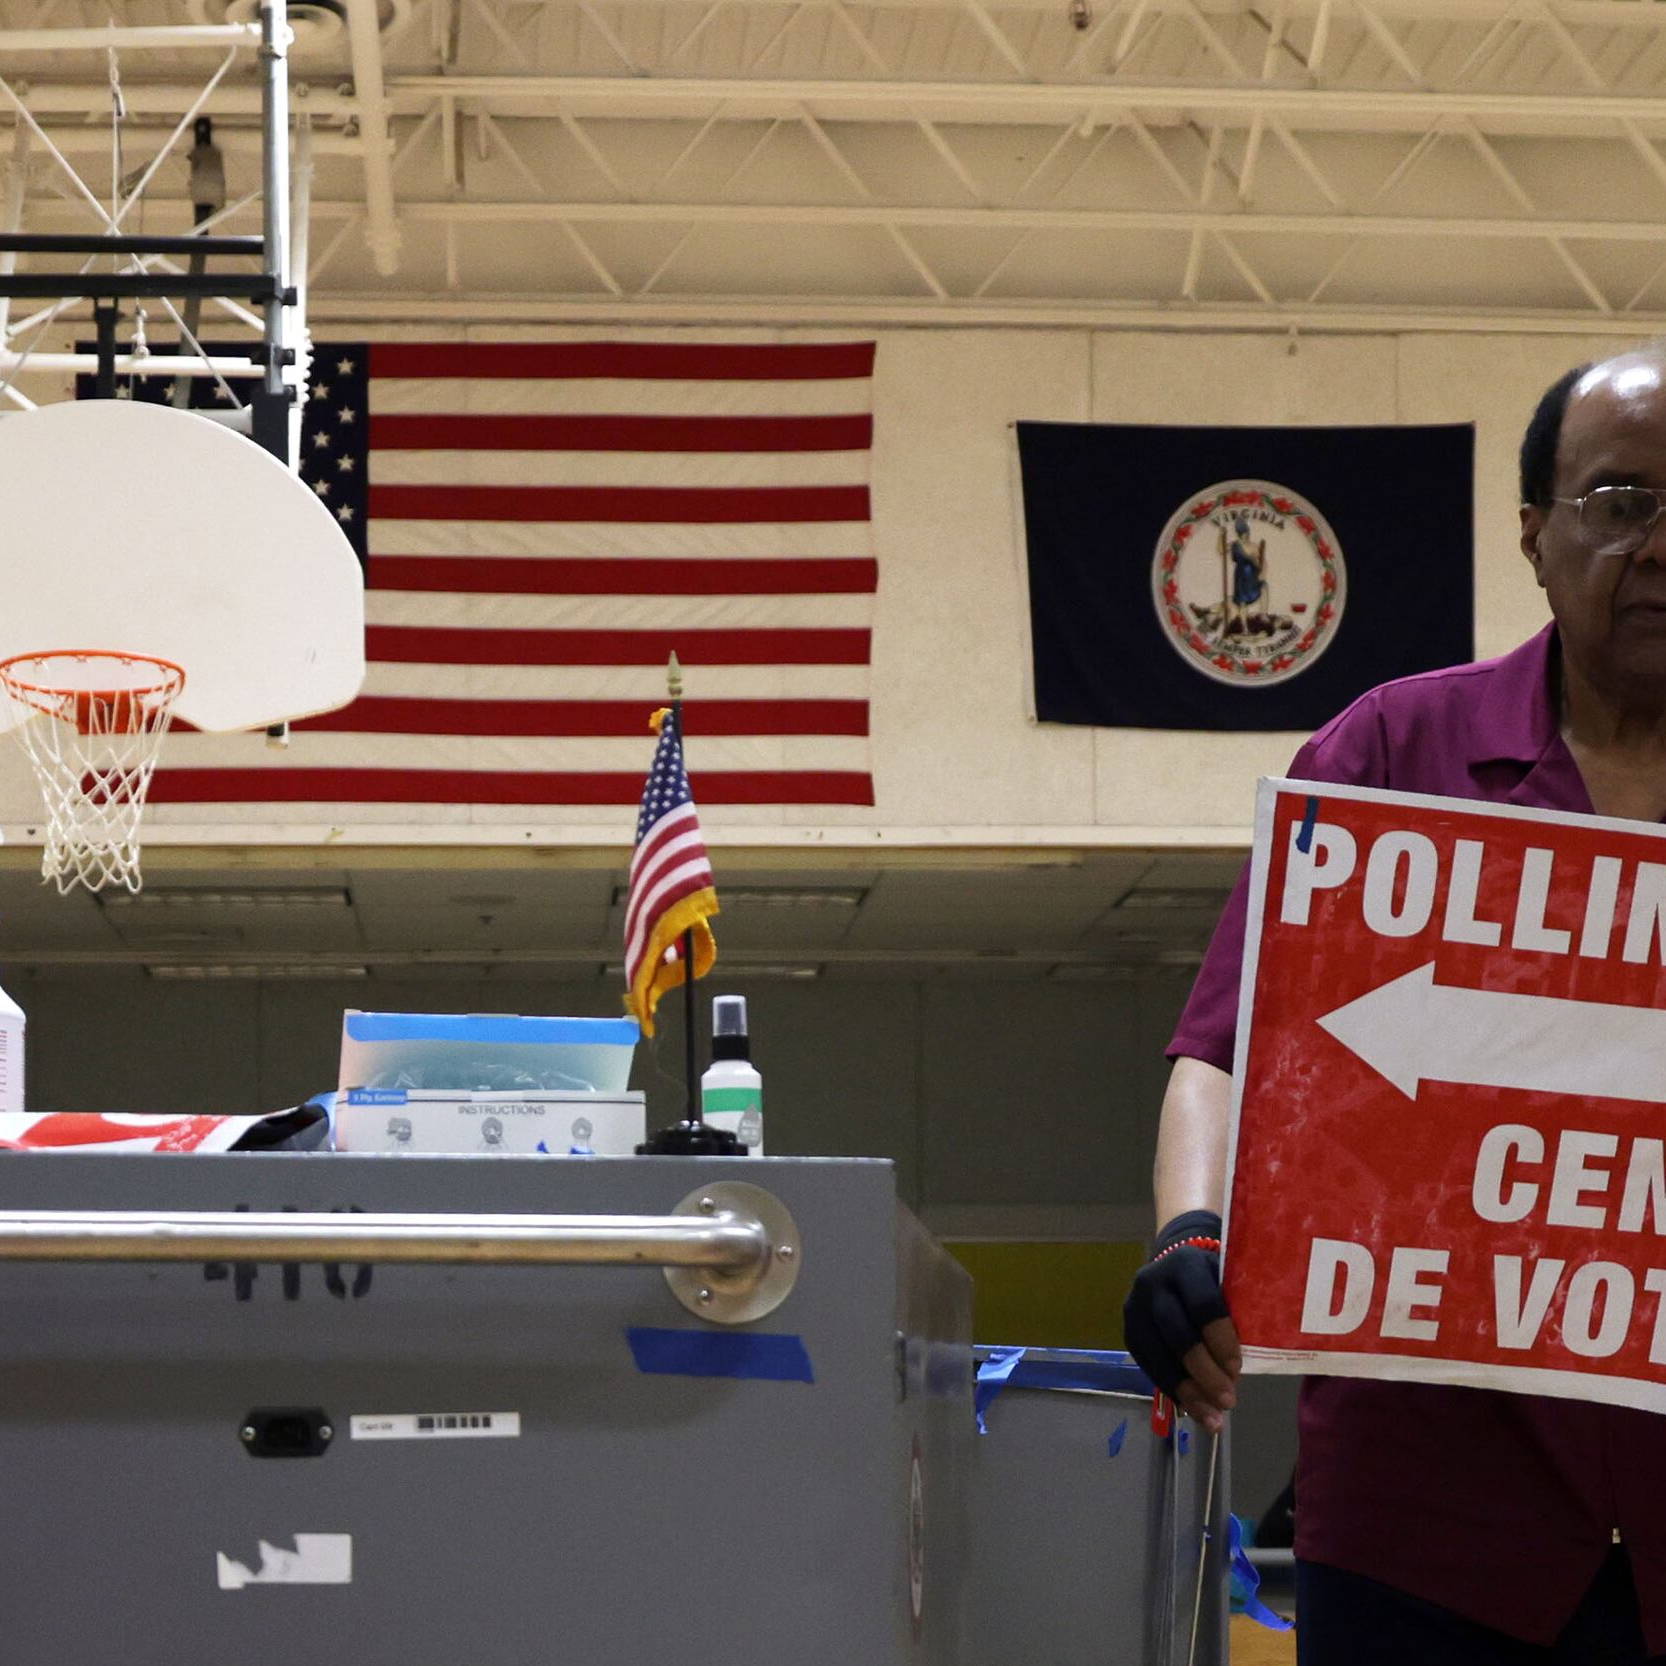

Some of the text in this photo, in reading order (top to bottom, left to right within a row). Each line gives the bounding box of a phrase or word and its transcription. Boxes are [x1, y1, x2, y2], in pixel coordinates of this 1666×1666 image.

[1212, 508, 1286, 530] VIRGINIA
[458, 1105, 546, 1115] INSTRUCTIONS
[1301, 1238, 1449, 1341] DE
